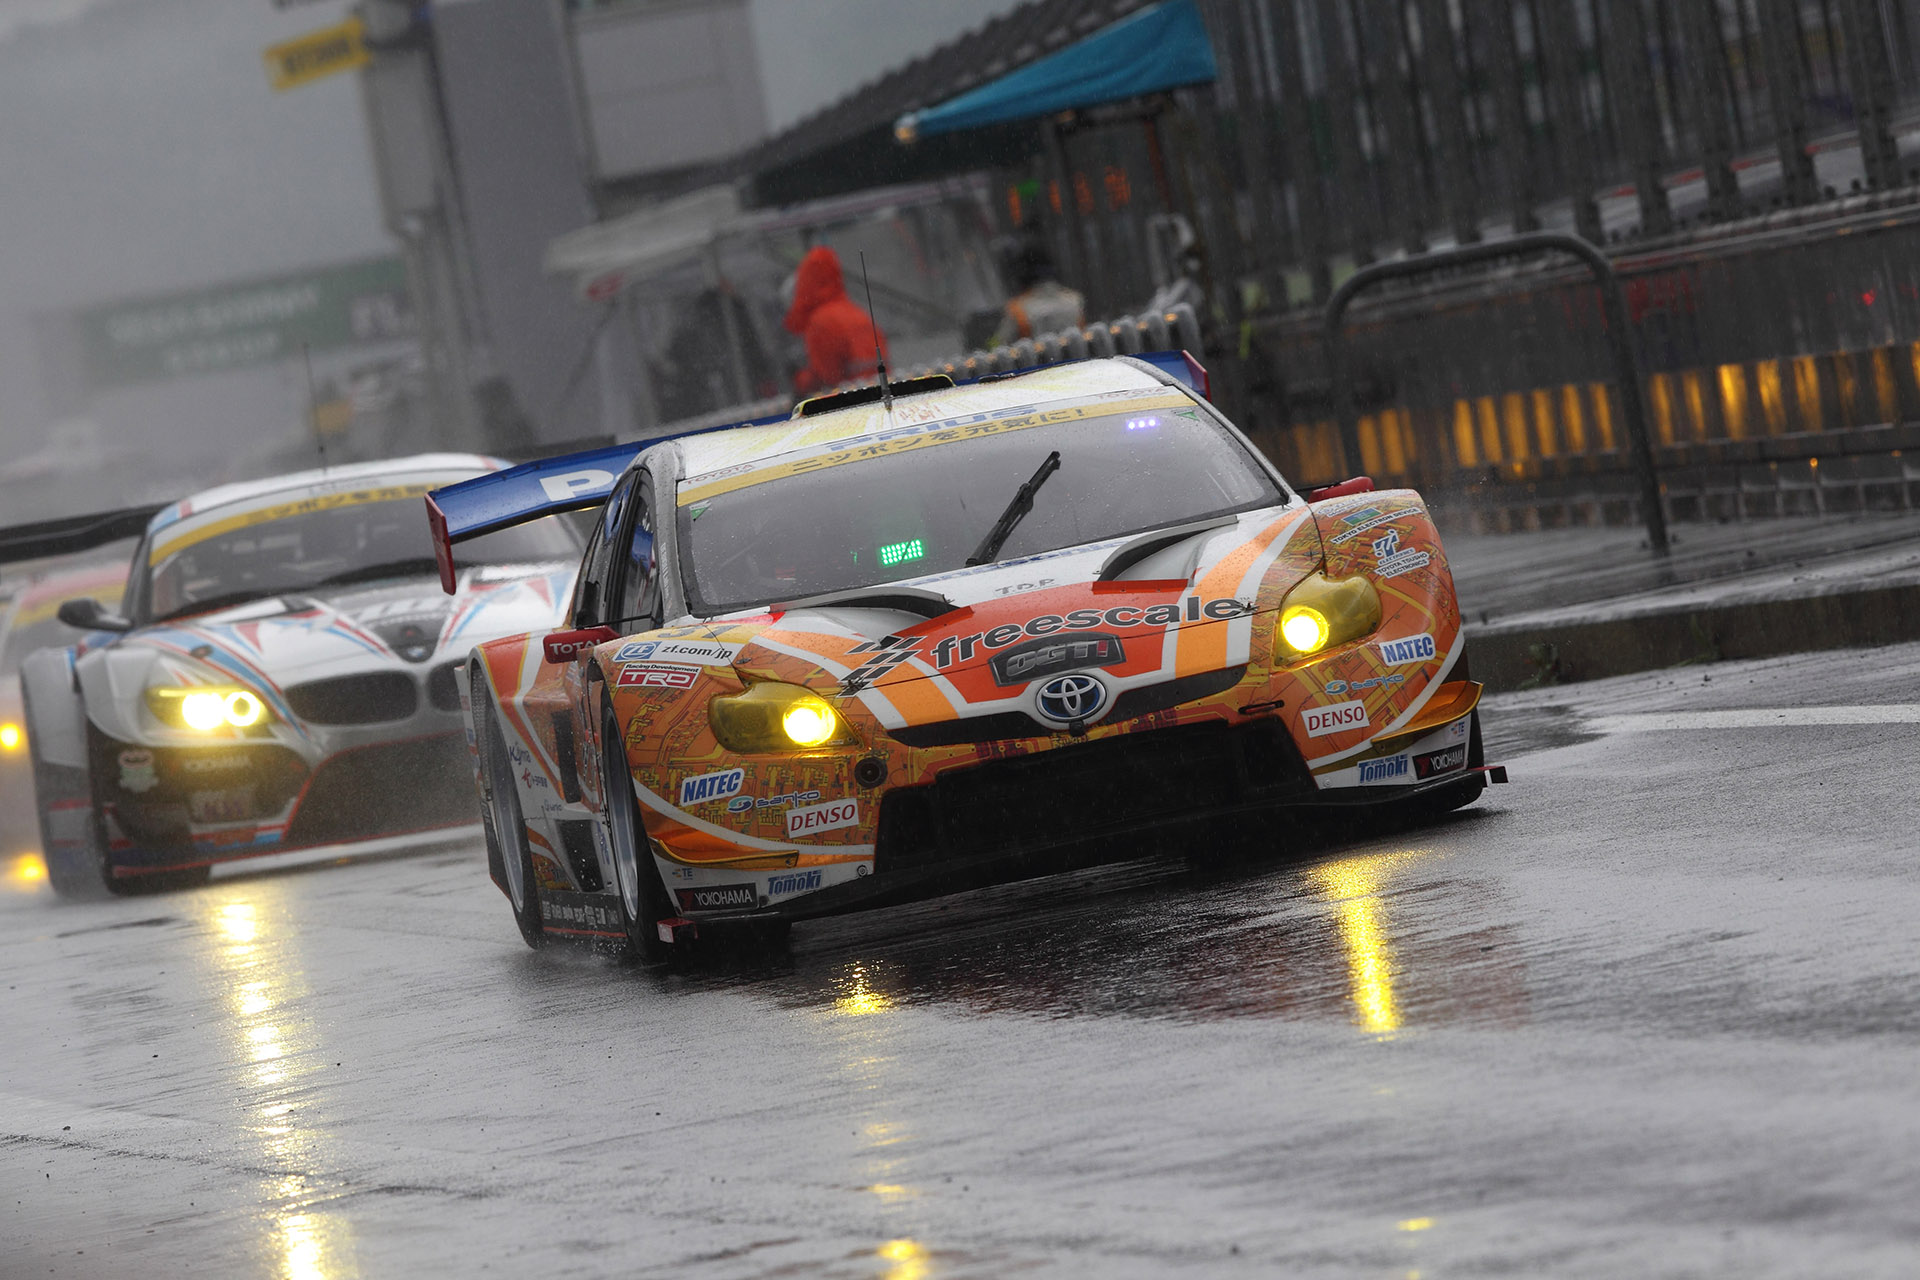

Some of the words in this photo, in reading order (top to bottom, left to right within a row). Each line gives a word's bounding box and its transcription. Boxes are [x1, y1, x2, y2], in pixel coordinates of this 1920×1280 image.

[1333, 530, 1357, 543] TOKYO
[1357, 515, 1394, 532] ELECTRON
[1394, 508, 1418, 517] DEVICE
[1378, 561, 1403, 574] TOYOTA
[1386, 559, 1428, 577] ELECTRONICS
[931, 596, 1244, 669] freescale
[550, 639, 601, 655] TOTA
[662, 645, 733, 659] zf.com/jp
[1383, 636, 1434, 663] NATEC
[650, 664, 699, 673] Development
[624, 671, 691, 686] TRD
[1351, 674, 1405, 691] sanko
[1308, 706, 1365, 731] DENSO
[1358, 754, 1408, 784] Tomoki
[1430, 749, 1464, 771] YOKOHAMA
[683, 771, 741, 803] NATEC
[756, 791, 820, 808] sanko
[790, 804, 856, 832] DENSO
[682, 868, 693, 877] TE
[767, 870, 822, 896] Tomoki
[695, 889, 753, 906] YOKOHAMA
